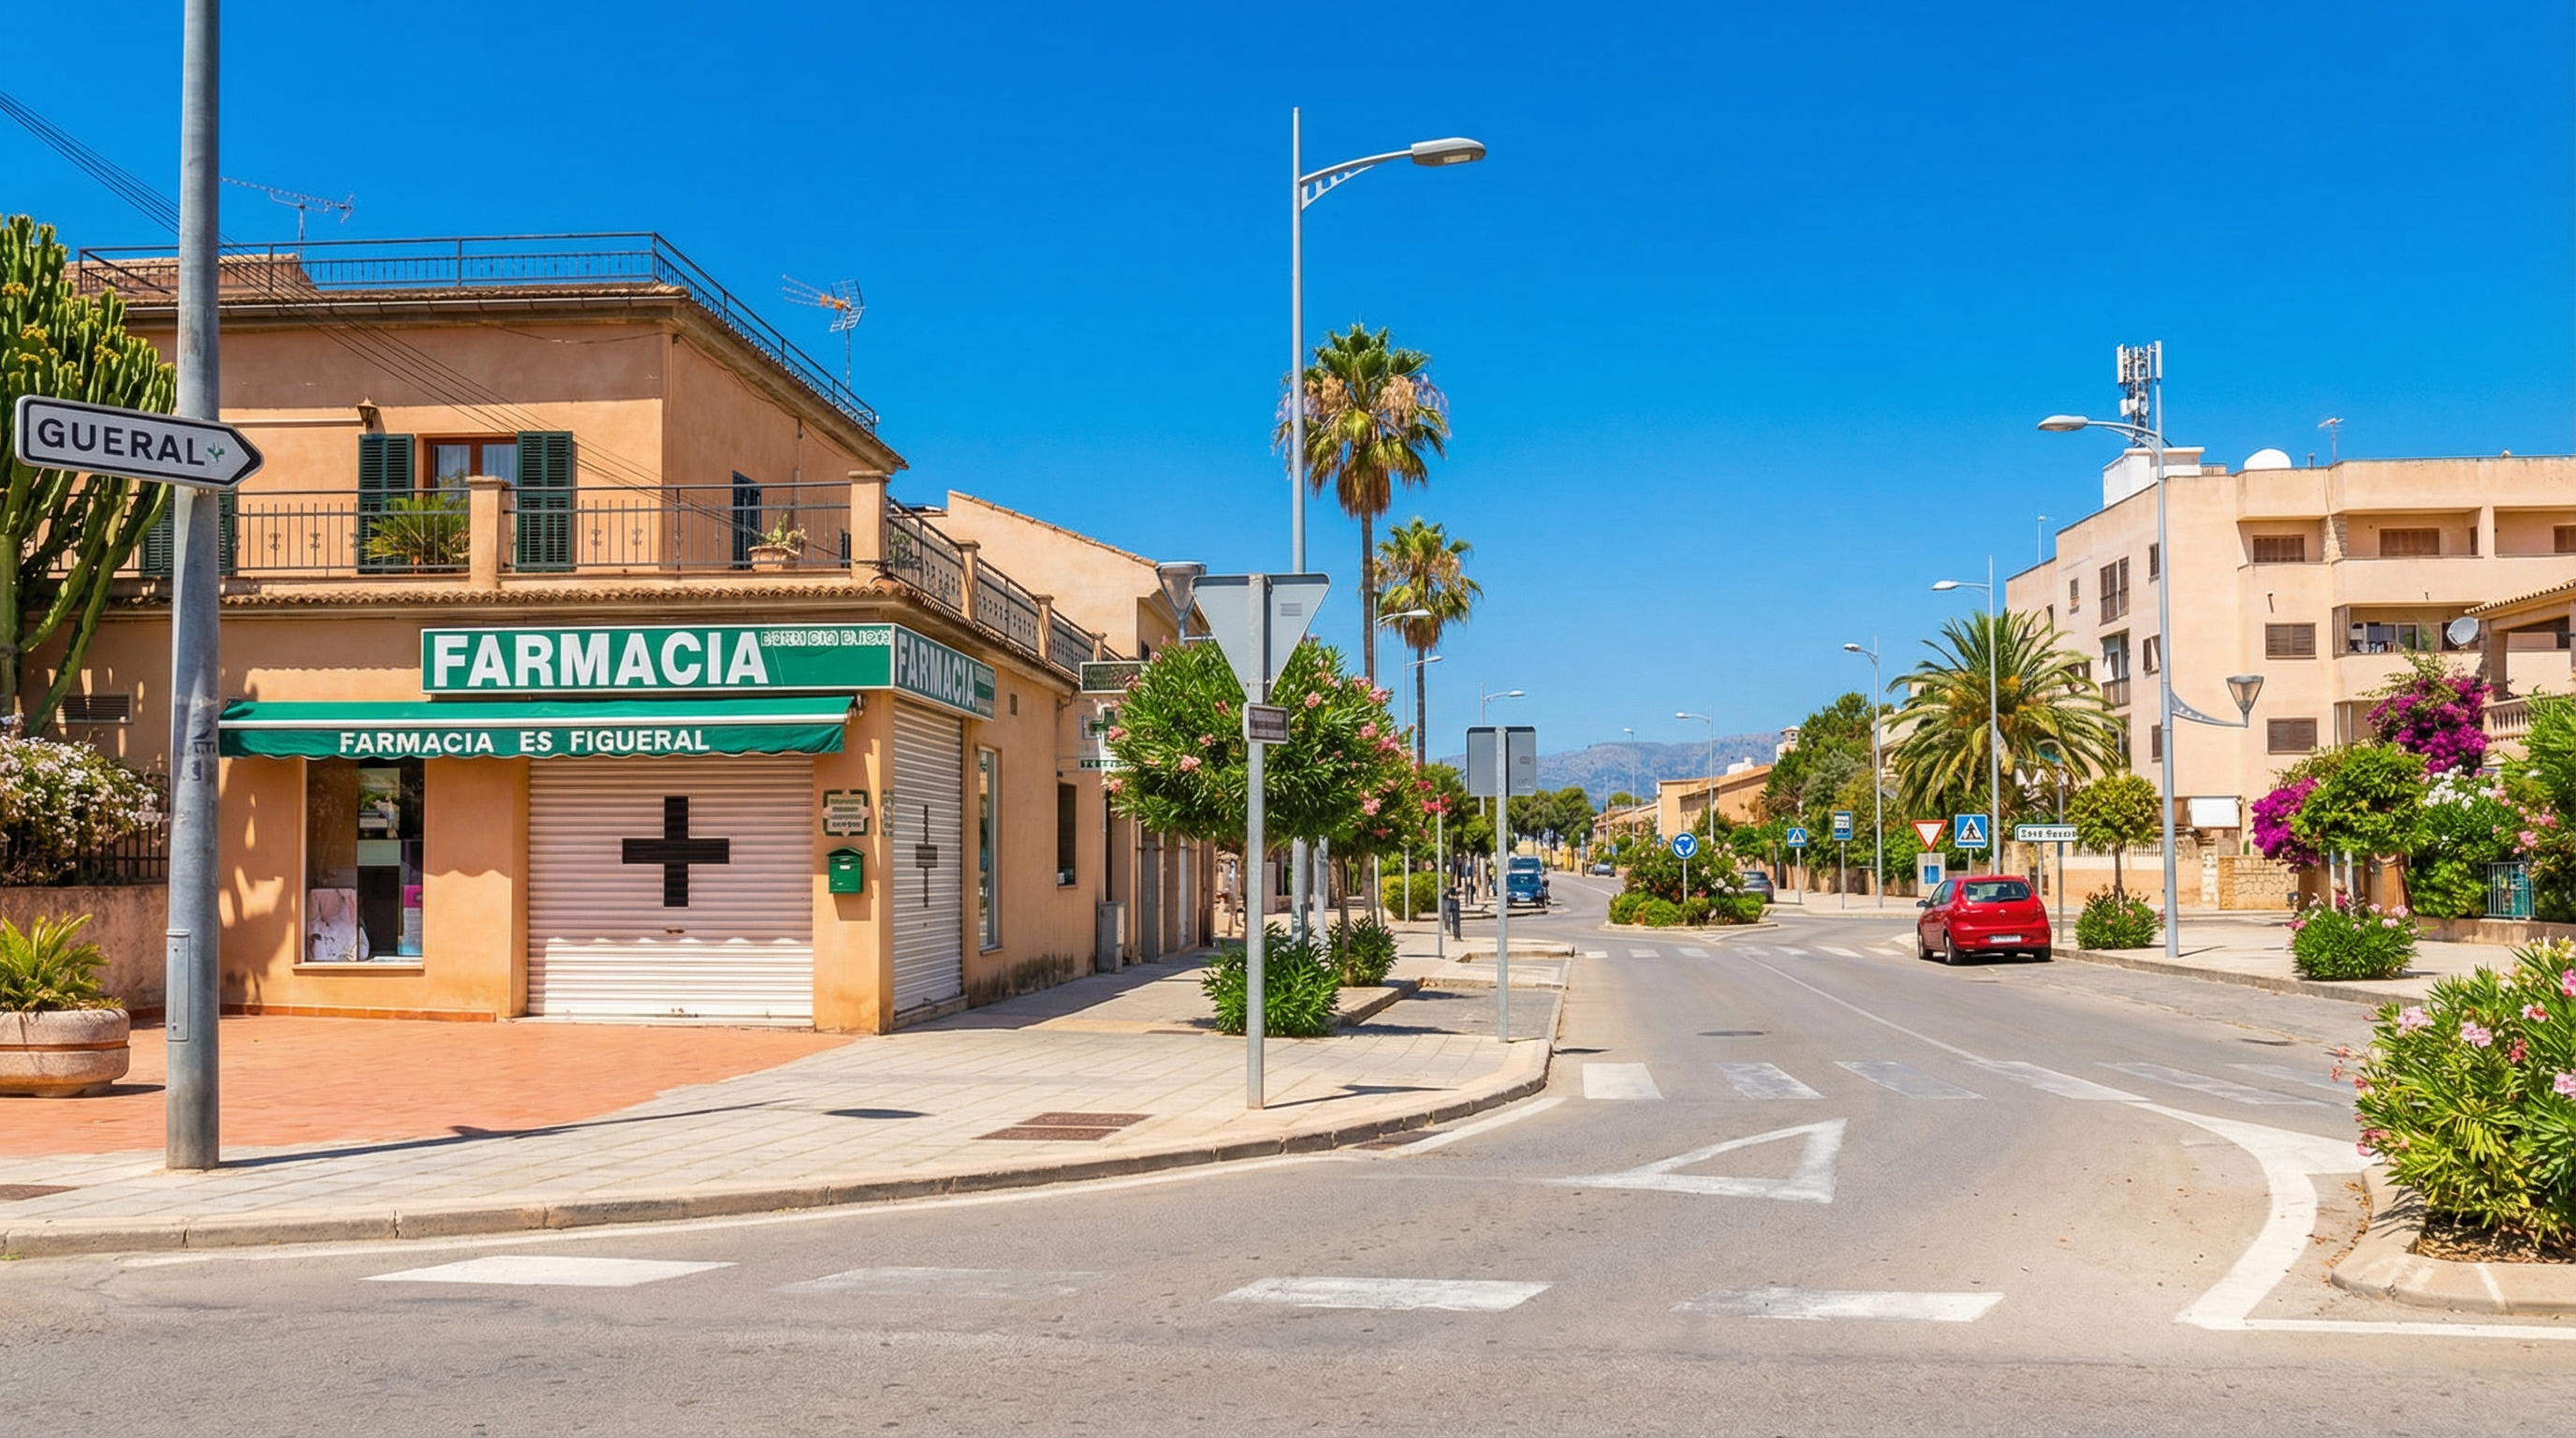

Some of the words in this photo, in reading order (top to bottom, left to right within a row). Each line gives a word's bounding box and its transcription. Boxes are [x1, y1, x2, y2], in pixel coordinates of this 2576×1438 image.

[37, 418, 205, 466] GUERAL
[433, 632, 768, 686] FARMACIA
[898, 633, 975, 708] FARMACIA
[340, 732, 494, 755] FARMACIA
[520, 731, 552, 753] ES
[570, 729, 710, 753] FIGUERAL
